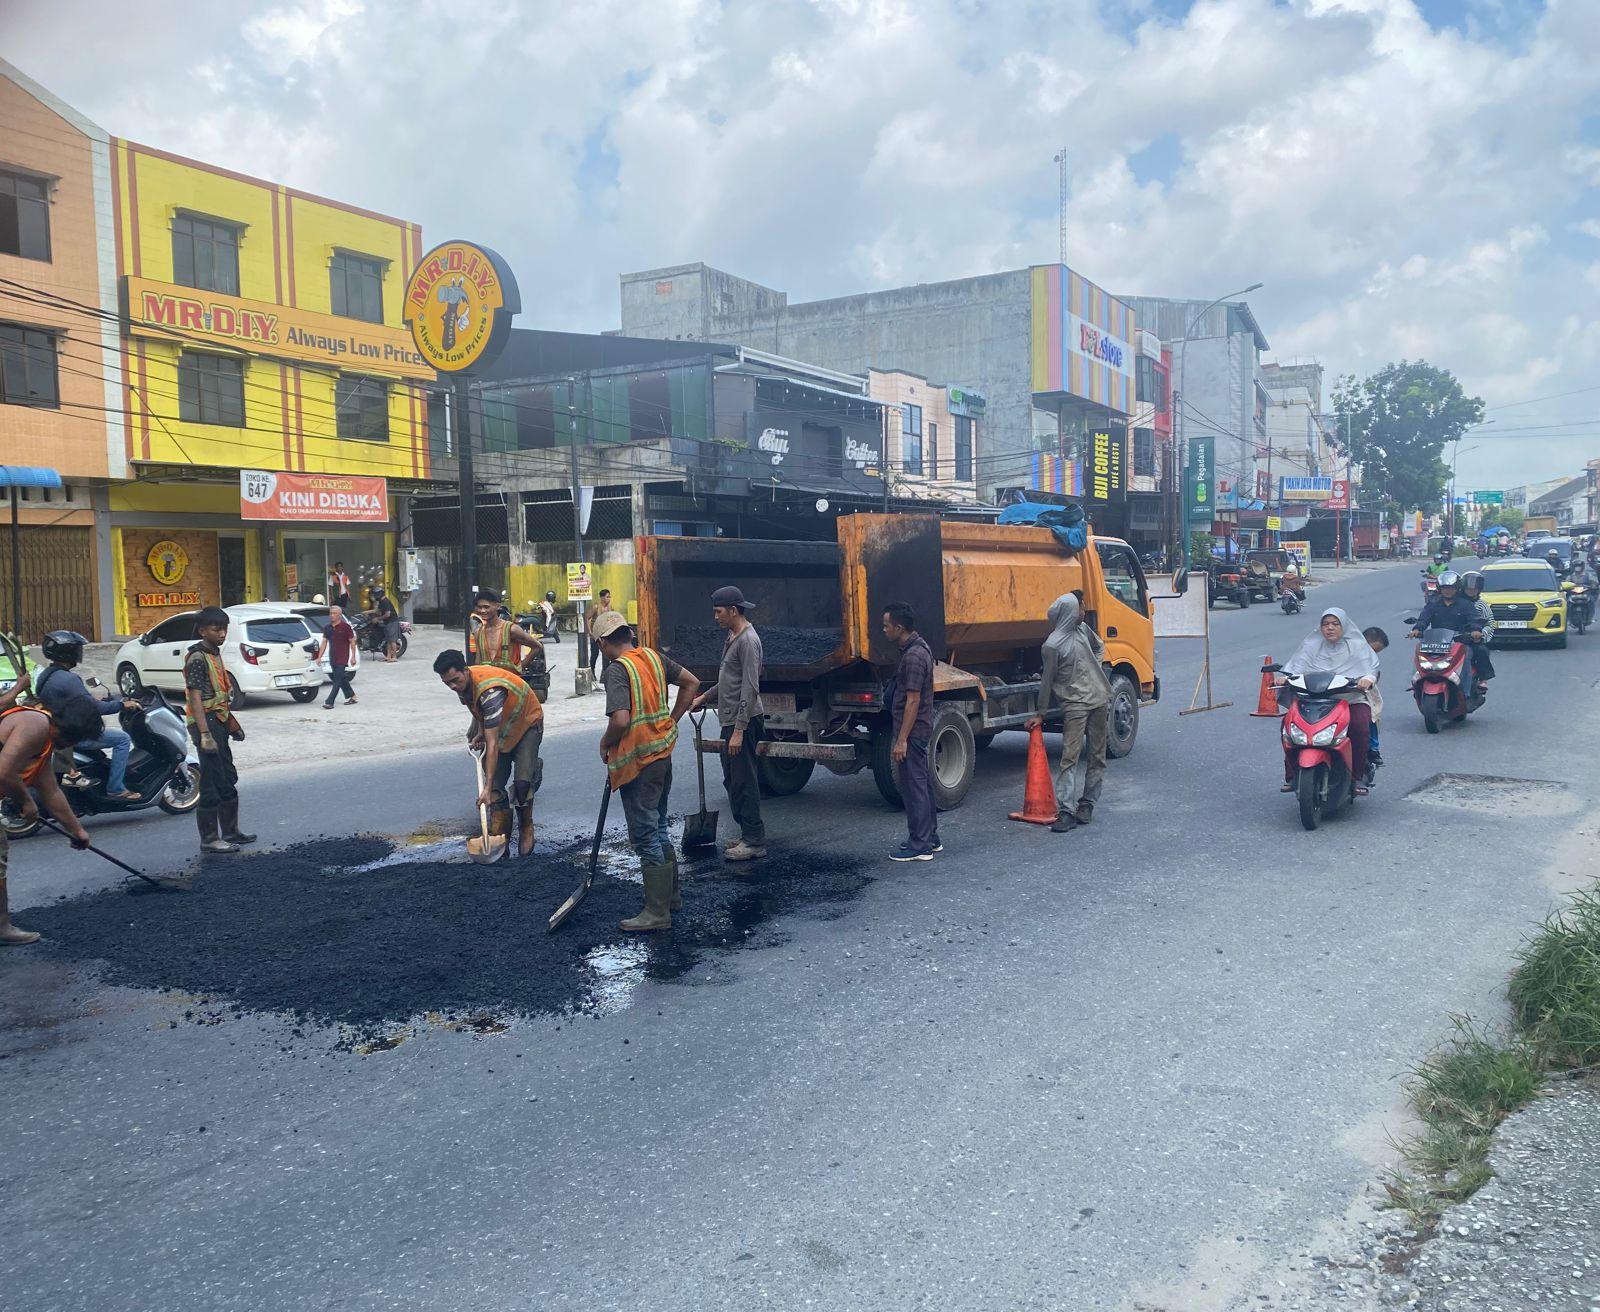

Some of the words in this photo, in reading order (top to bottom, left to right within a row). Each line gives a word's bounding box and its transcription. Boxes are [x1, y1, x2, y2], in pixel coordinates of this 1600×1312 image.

[286, 326, 347, 356] Always
[350, 337, 380, 359] Low
[419, 324, 443, 360] Always
[445, 352, 464, 362] Low
[465, 317, 486, 354] Prices
[1094, 432, 1109, 475] COFFEE
[1111, 442, 1120, 465] RESTO
[245, 474, 261, 483] TOKO
[262, 475, 271, 483] KE
[1312, 477, 1332, 491] MOTOR
[248, 482, 268, 498] 647
[279, 491, 315, 507] KINI
[321, 493, 382, 509] DIBUKA
